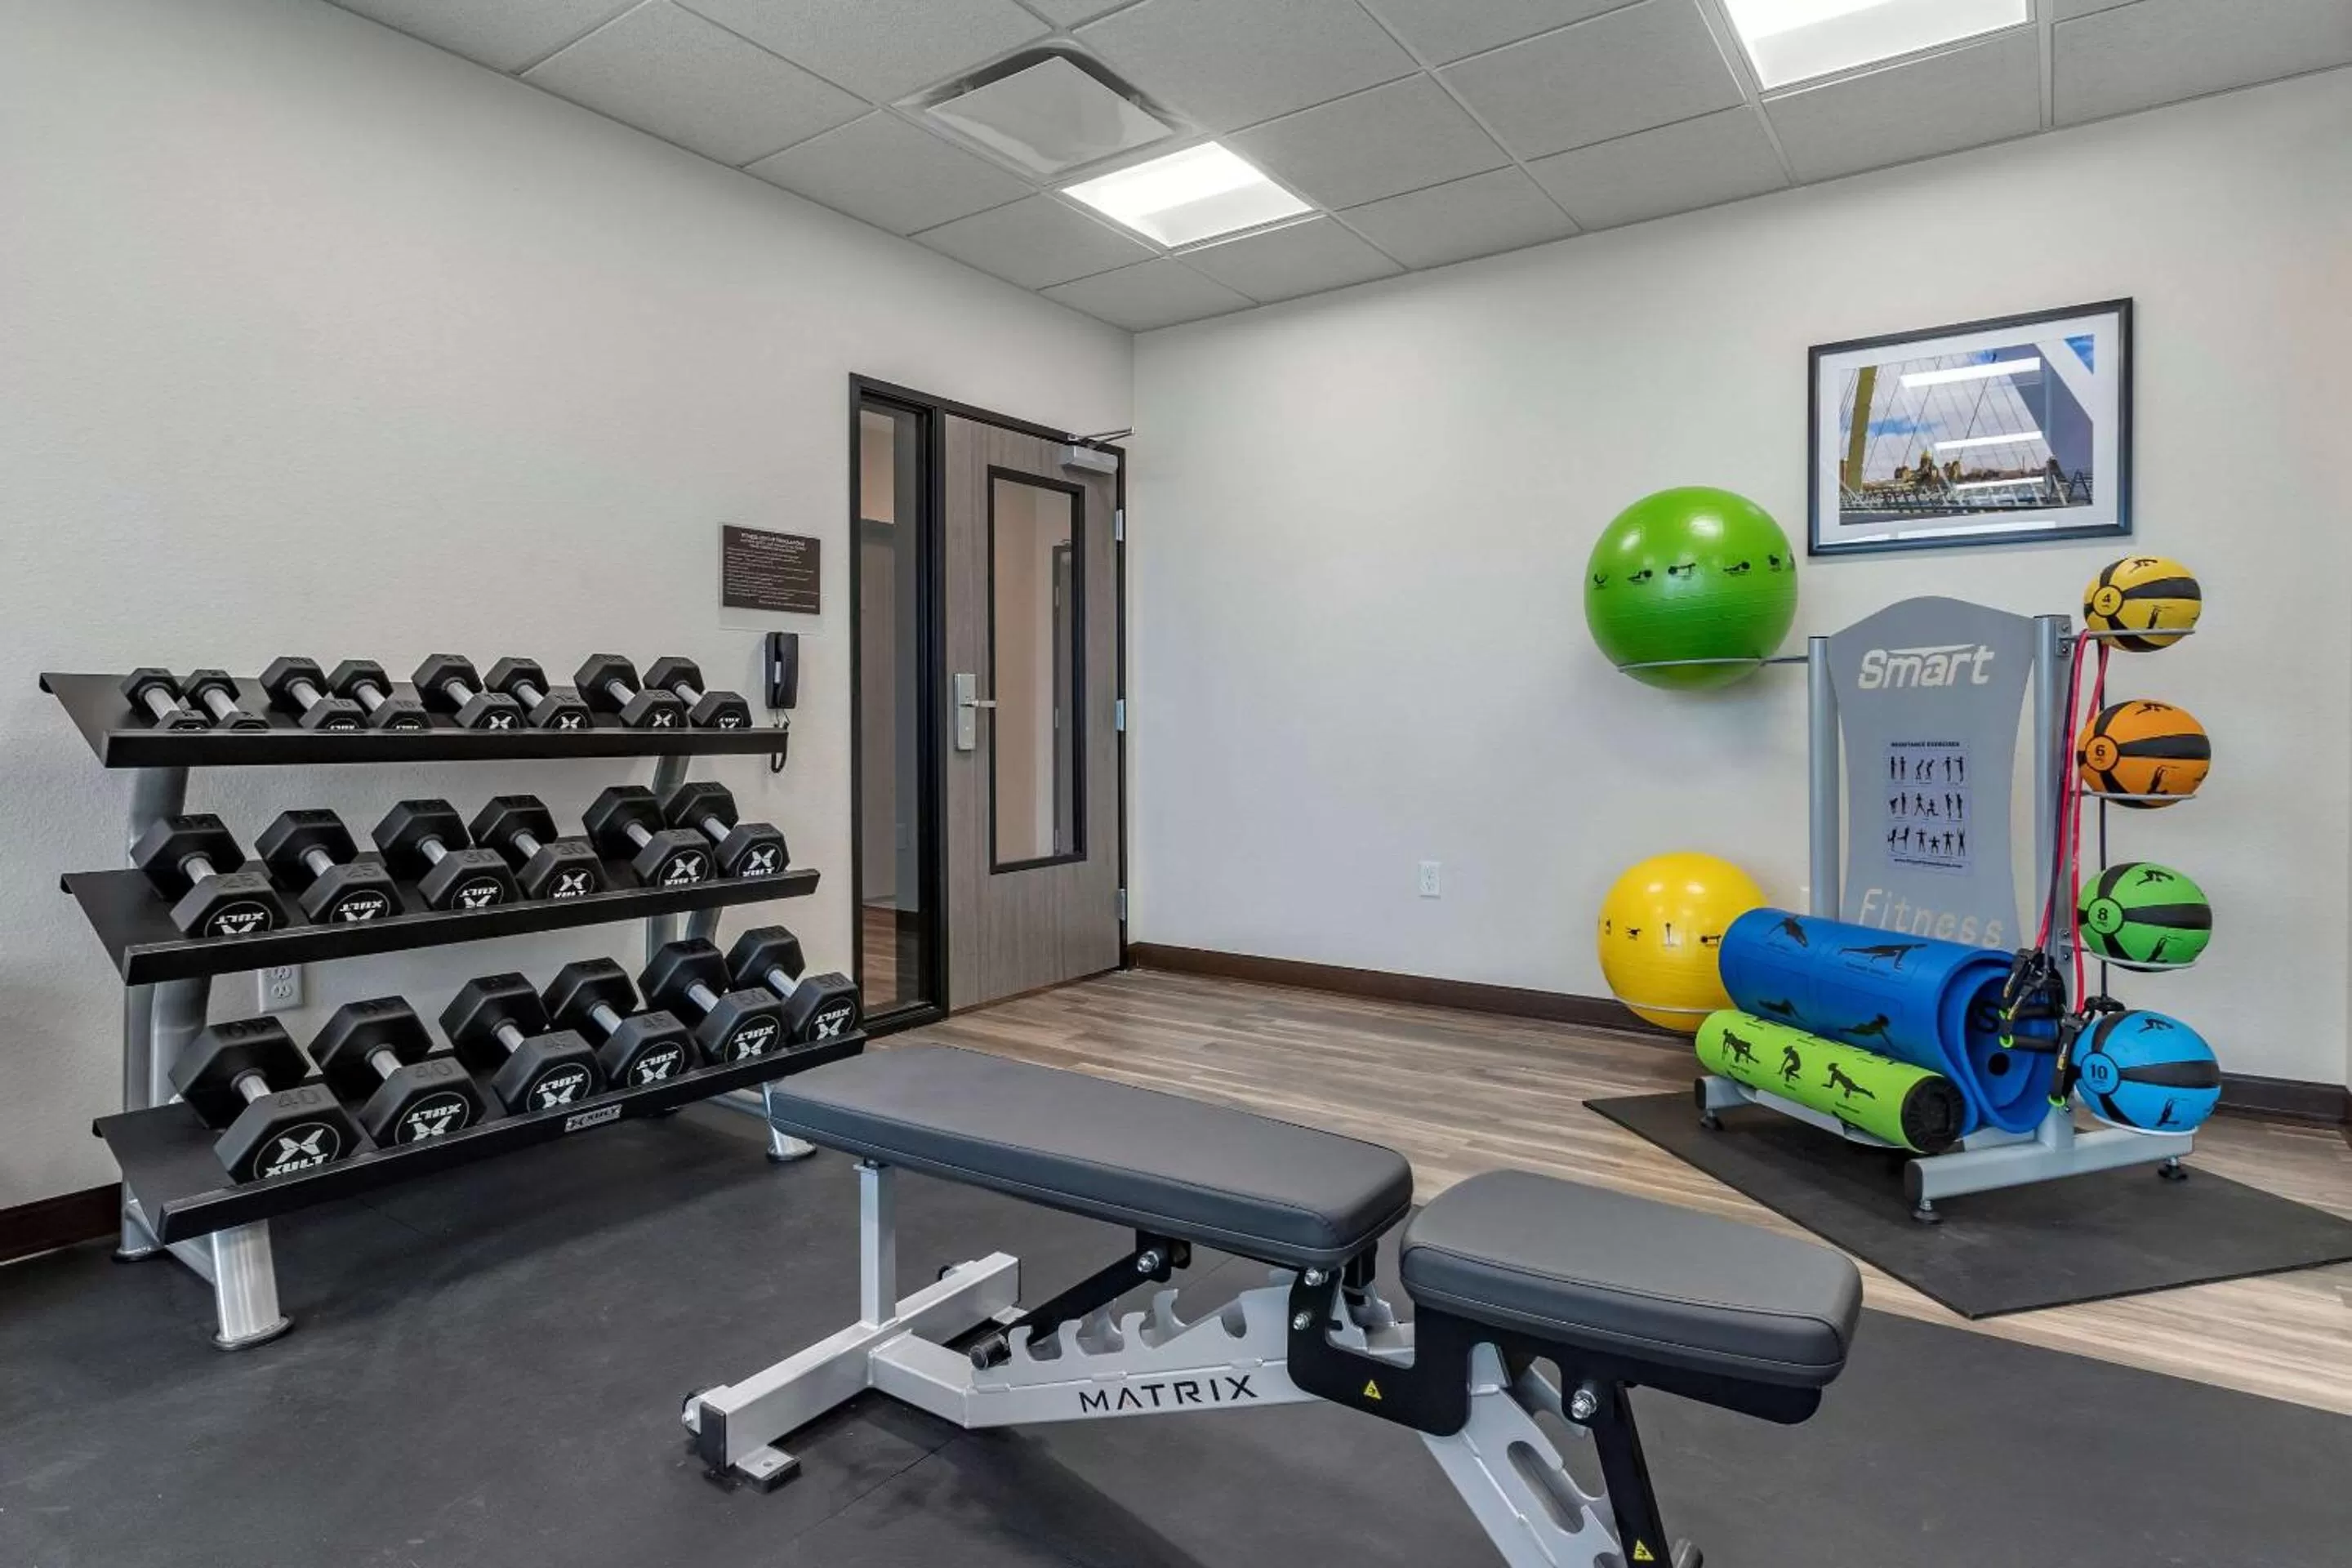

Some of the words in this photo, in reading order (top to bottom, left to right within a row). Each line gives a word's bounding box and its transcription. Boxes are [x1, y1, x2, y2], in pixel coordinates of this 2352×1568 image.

[2101, 593, 2111, 603] 4
[1858, 644, 1995, 689] Smart
[2096, 744, 2106, 756] 6
[1859, 889, 2003, 947] Fitness
[2098, 907, 2108, 920] 8
[2090, 1064, 2108, 1079] 10
[537, 1073, 584, 1093] XULT
[407, 1103, 461, 1123] XULT
[265, 1152, 328, 1178] XULT
[1079, 1374, 1258, 1413] MATRIX
